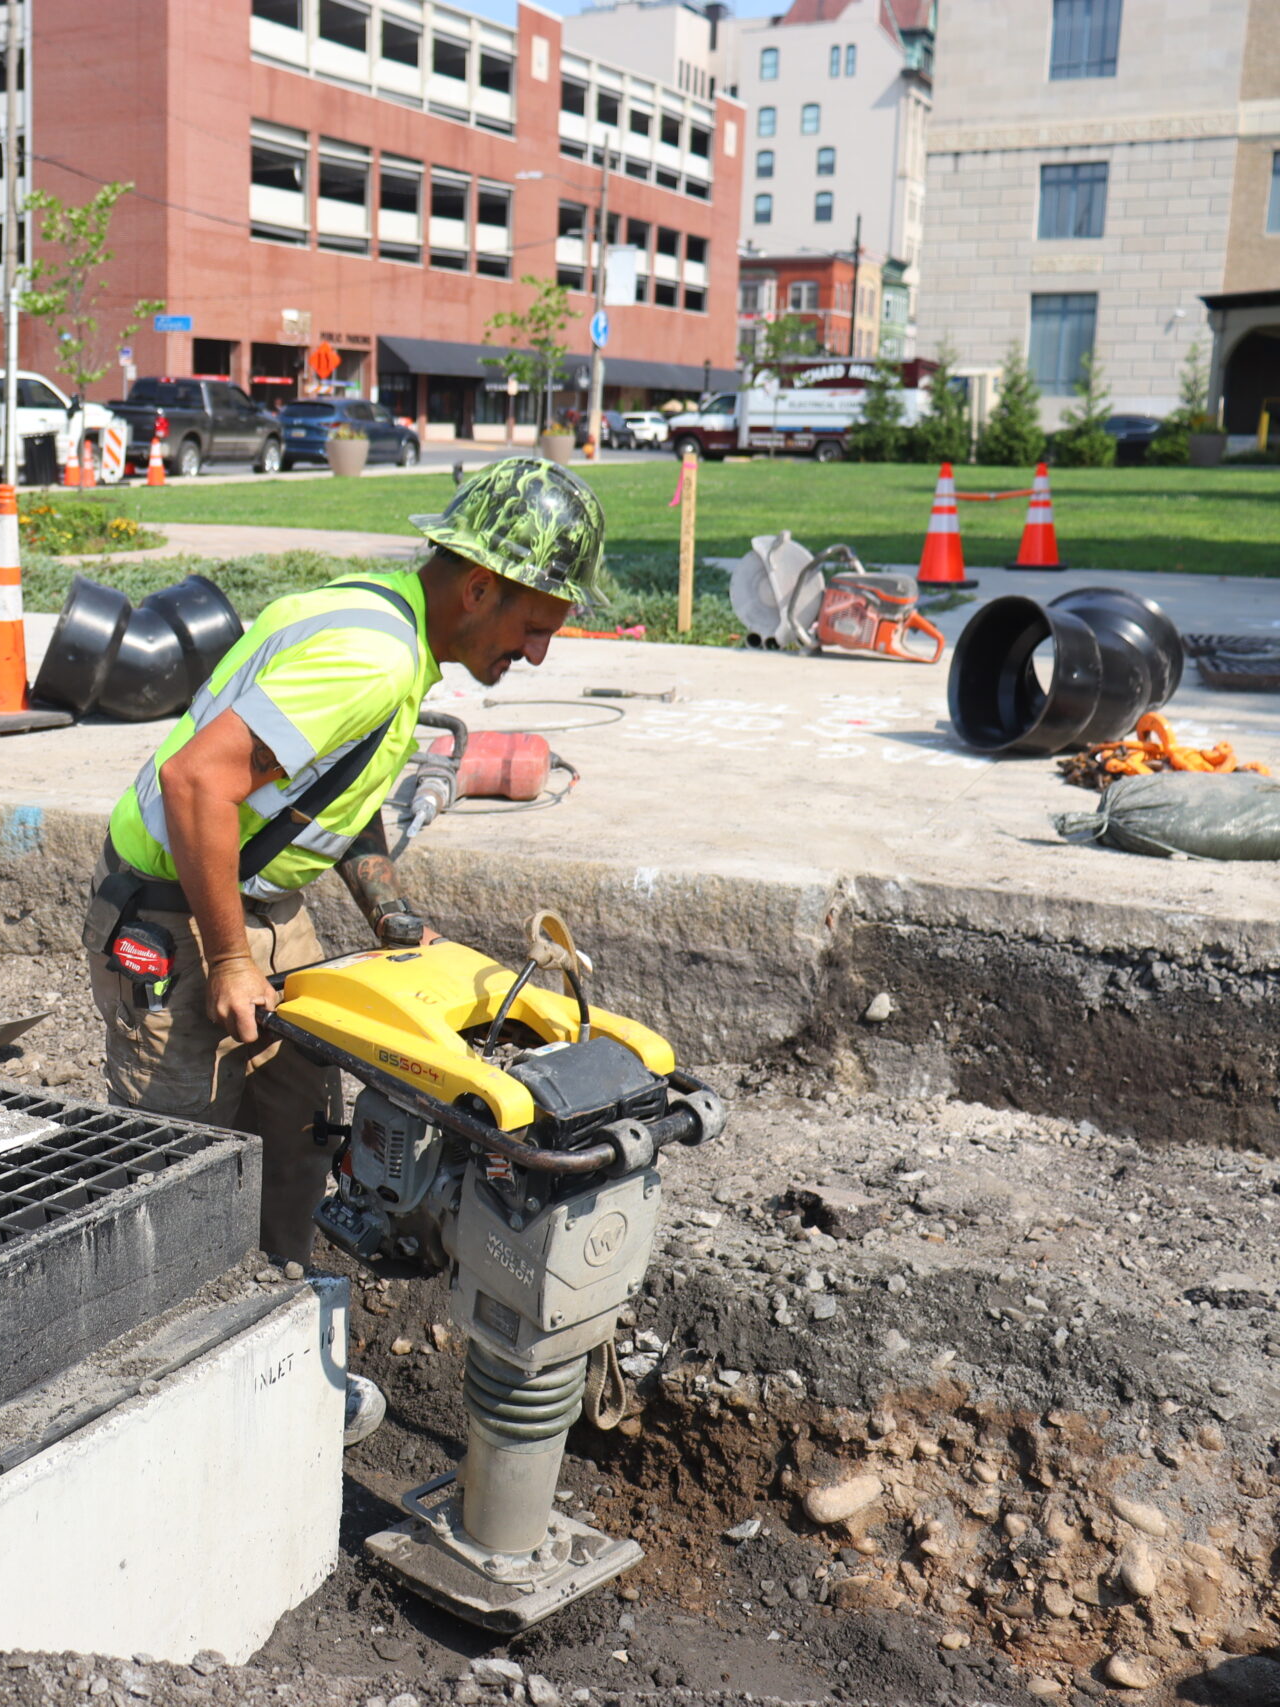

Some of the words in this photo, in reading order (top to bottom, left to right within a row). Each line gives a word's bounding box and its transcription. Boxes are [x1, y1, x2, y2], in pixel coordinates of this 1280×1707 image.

[119, 940, 158, 959] Milwaukee
[485, 1243, 534, 1289] NEUSON
[254, 1352, 295, 1394] INLET
